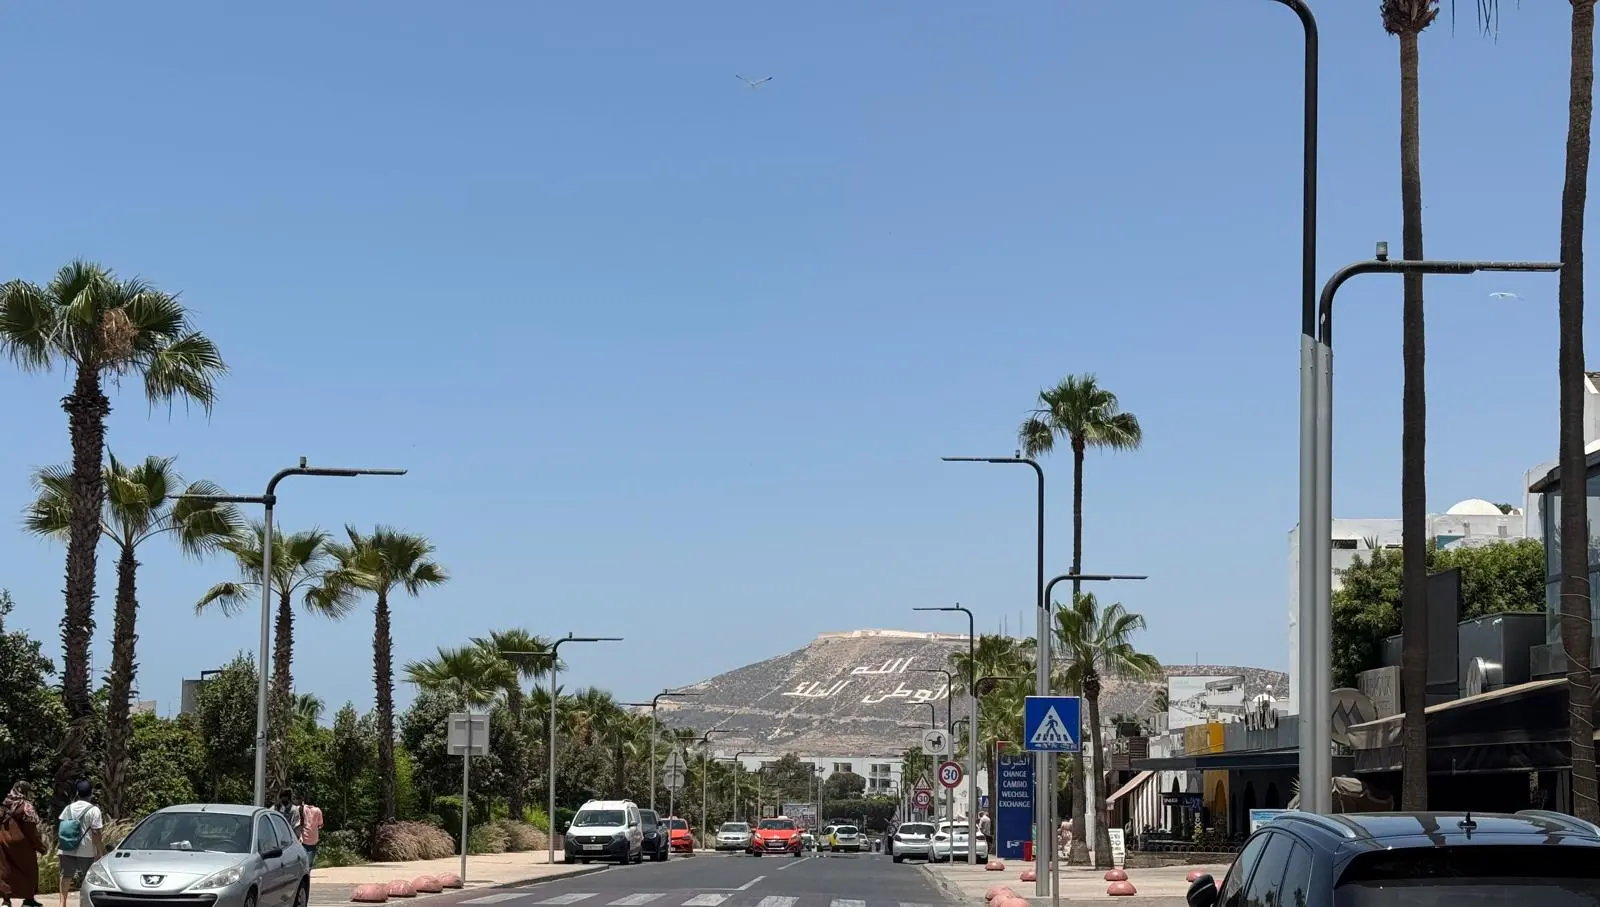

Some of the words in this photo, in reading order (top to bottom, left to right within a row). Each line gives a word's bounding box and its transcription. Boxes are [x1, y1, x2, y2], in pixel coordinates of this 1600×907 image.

[850, 656, 915, 675] الله
[943, 768, 958, 781] 30
[1003, 770, 1027, 778] CHANGE
[1002, 780, 1028, 788] CAMBIO
[1001, 790, 1029, 798] WECHSEL
[918, 795, 928, 803] 30
[999, 800, 1031, 808] EXCHANGE
